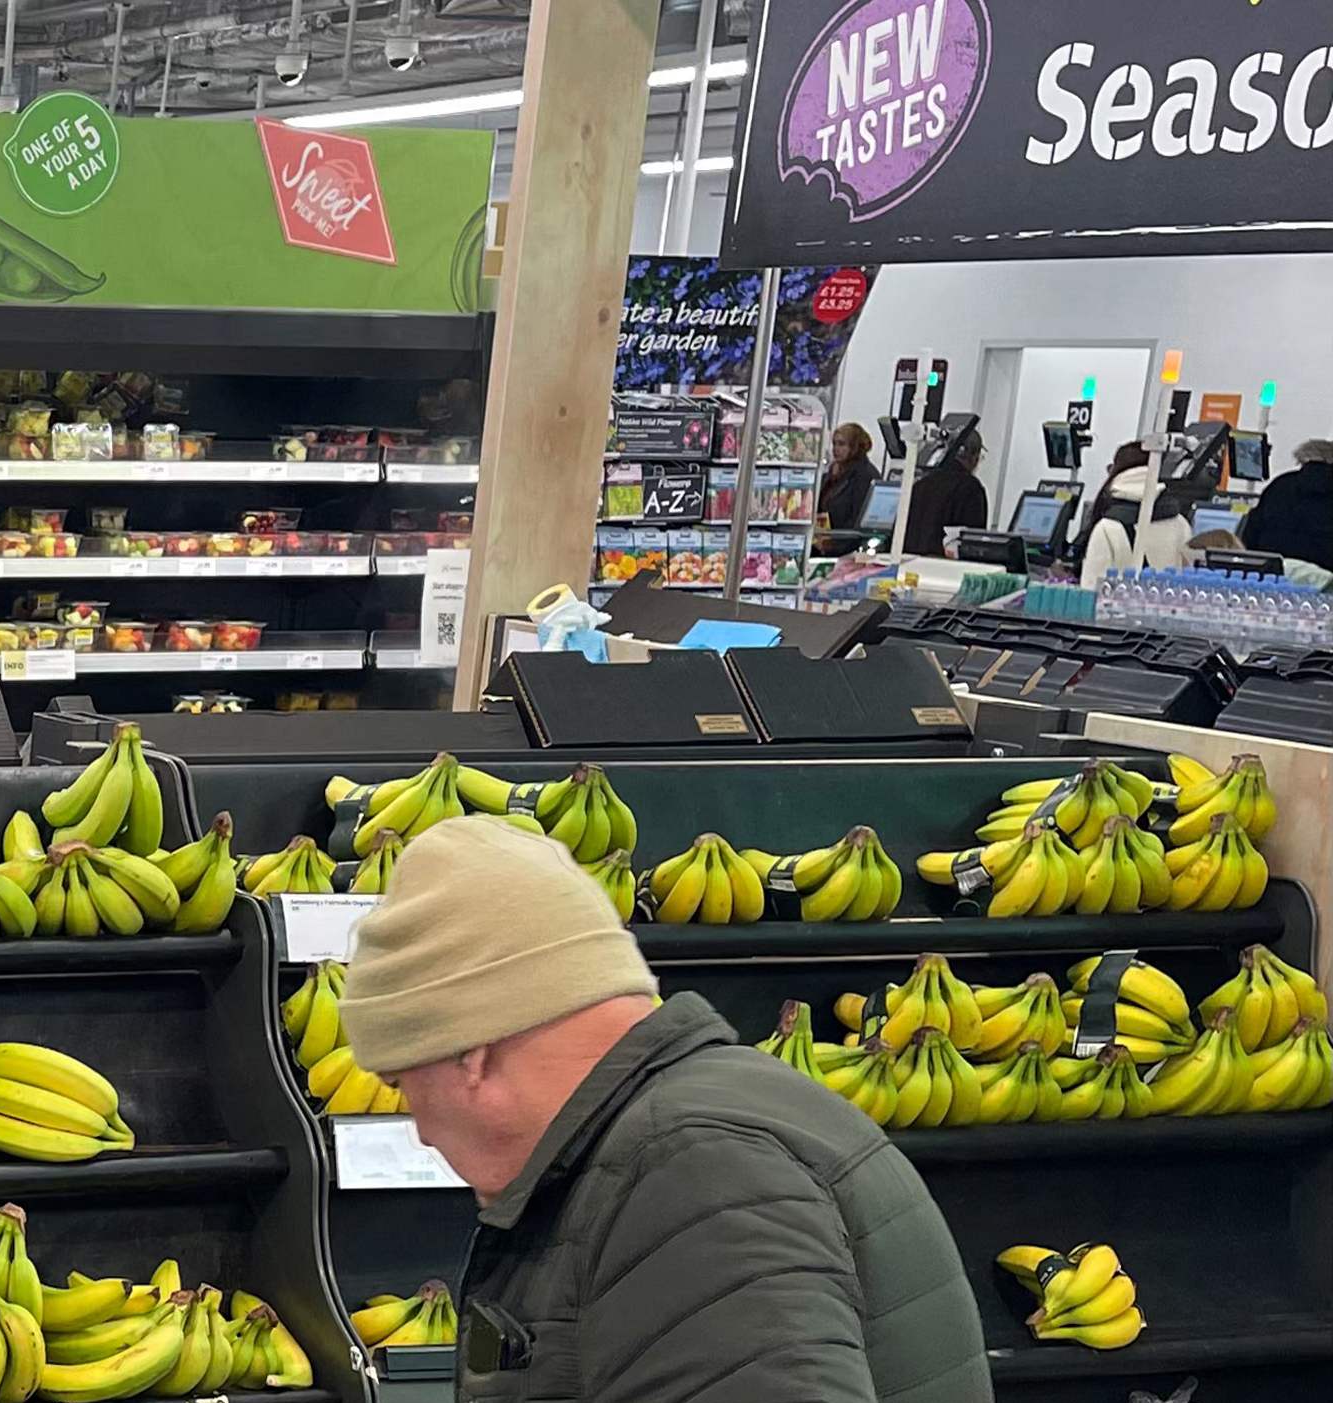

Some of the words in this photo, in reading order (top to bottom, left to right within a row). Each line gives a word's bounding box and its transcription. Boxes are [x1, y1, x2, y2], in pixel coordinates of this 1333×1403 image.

[826, 4, 945, 116] NEW
[21, 132, 54, 165] ONE
[52, 118, 71, 143] OF
[74, 114, 101, 150] 5
[815, 82, 947, 171] TASTES
[41, 142, 82, 178] YOUR
[67, 172, 81, 190] A
[78, 150, 108, 181] DAY
[282, 141, 373, 231] Sweet
[639, 329, 717, 354] garden
[1070, 407, 1089, 424] 20
